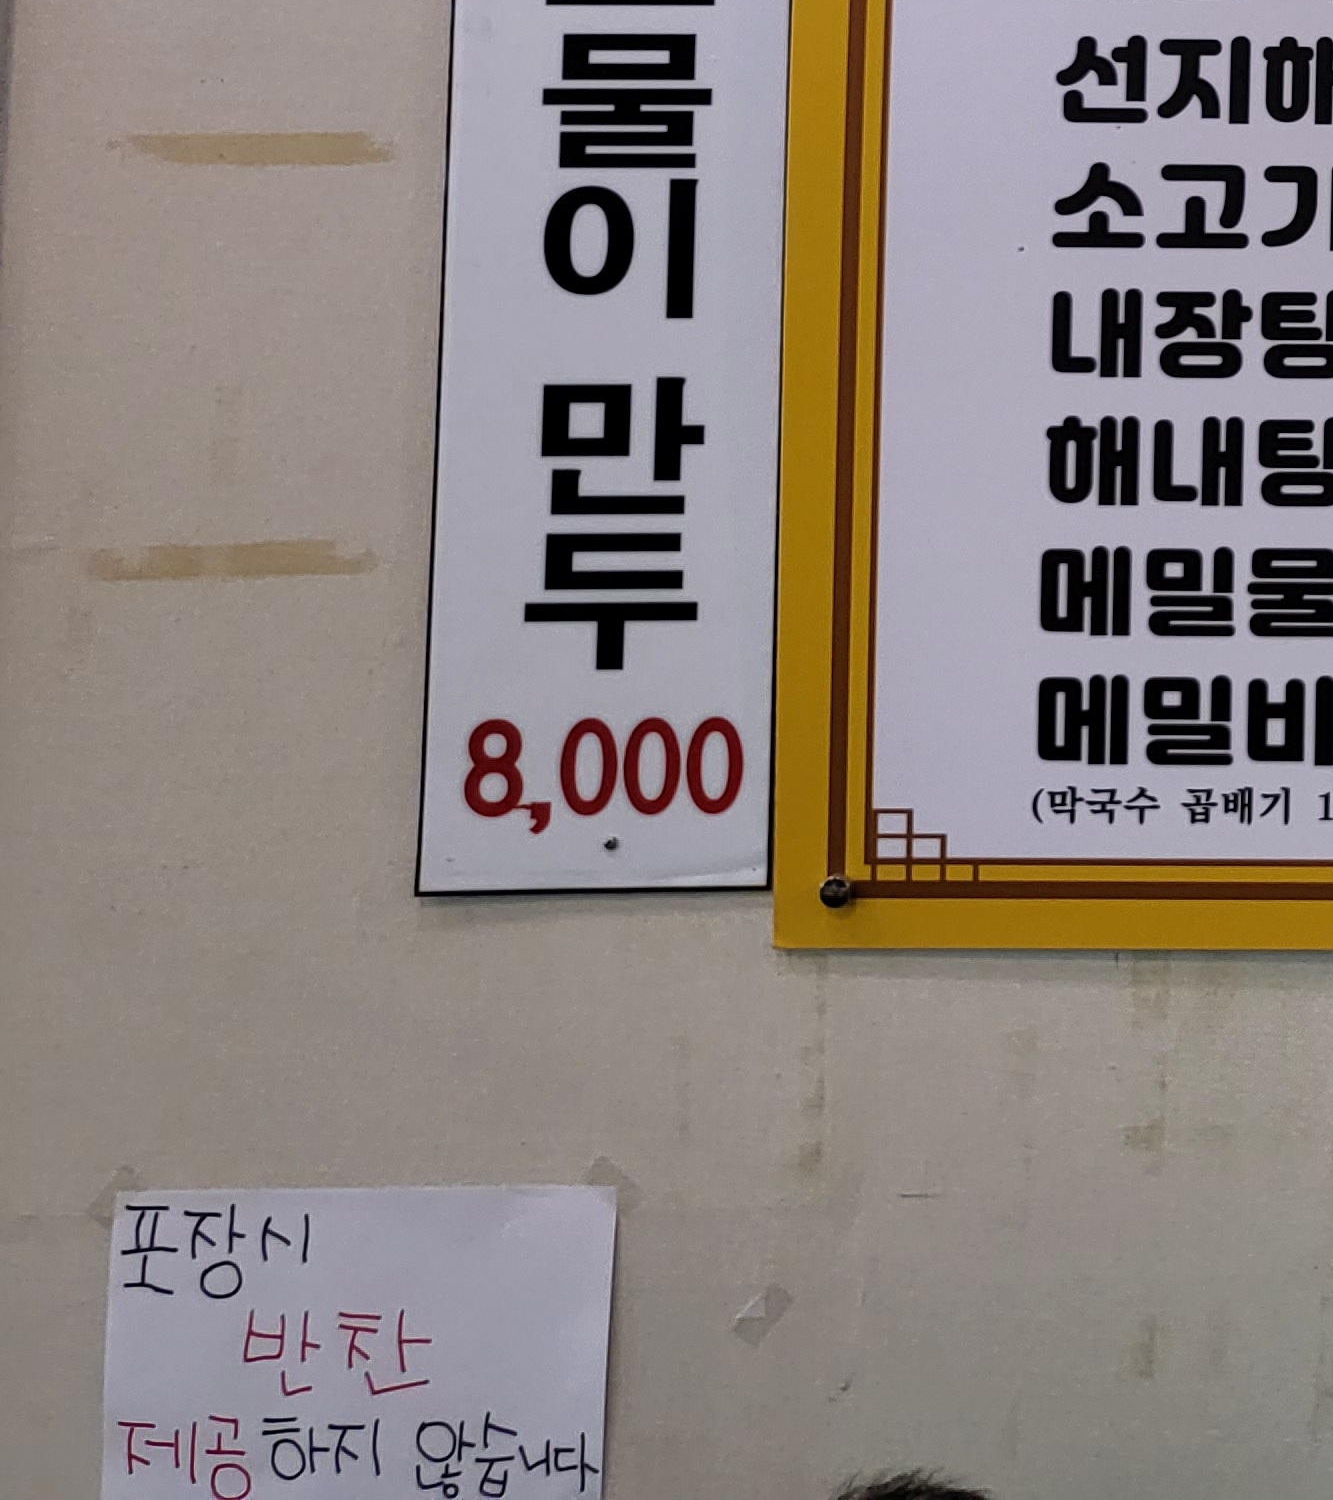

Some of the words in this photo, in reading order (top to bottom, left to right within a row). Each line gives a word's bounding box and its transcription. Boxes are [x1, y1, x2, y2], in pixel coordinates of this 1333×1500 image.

[523, 376, 705, 671] 만두
[463, 716, 744, 835] 8,000
[1031, 785, 1161, 826] (막국수
[1180, 786, 1291, 826] 곱배기
[120, 1203, 310, 1300] 포장시
[117, 1415, 381, 1500] 제공하지
[415, 1410, 601, 1500] 않습니다
